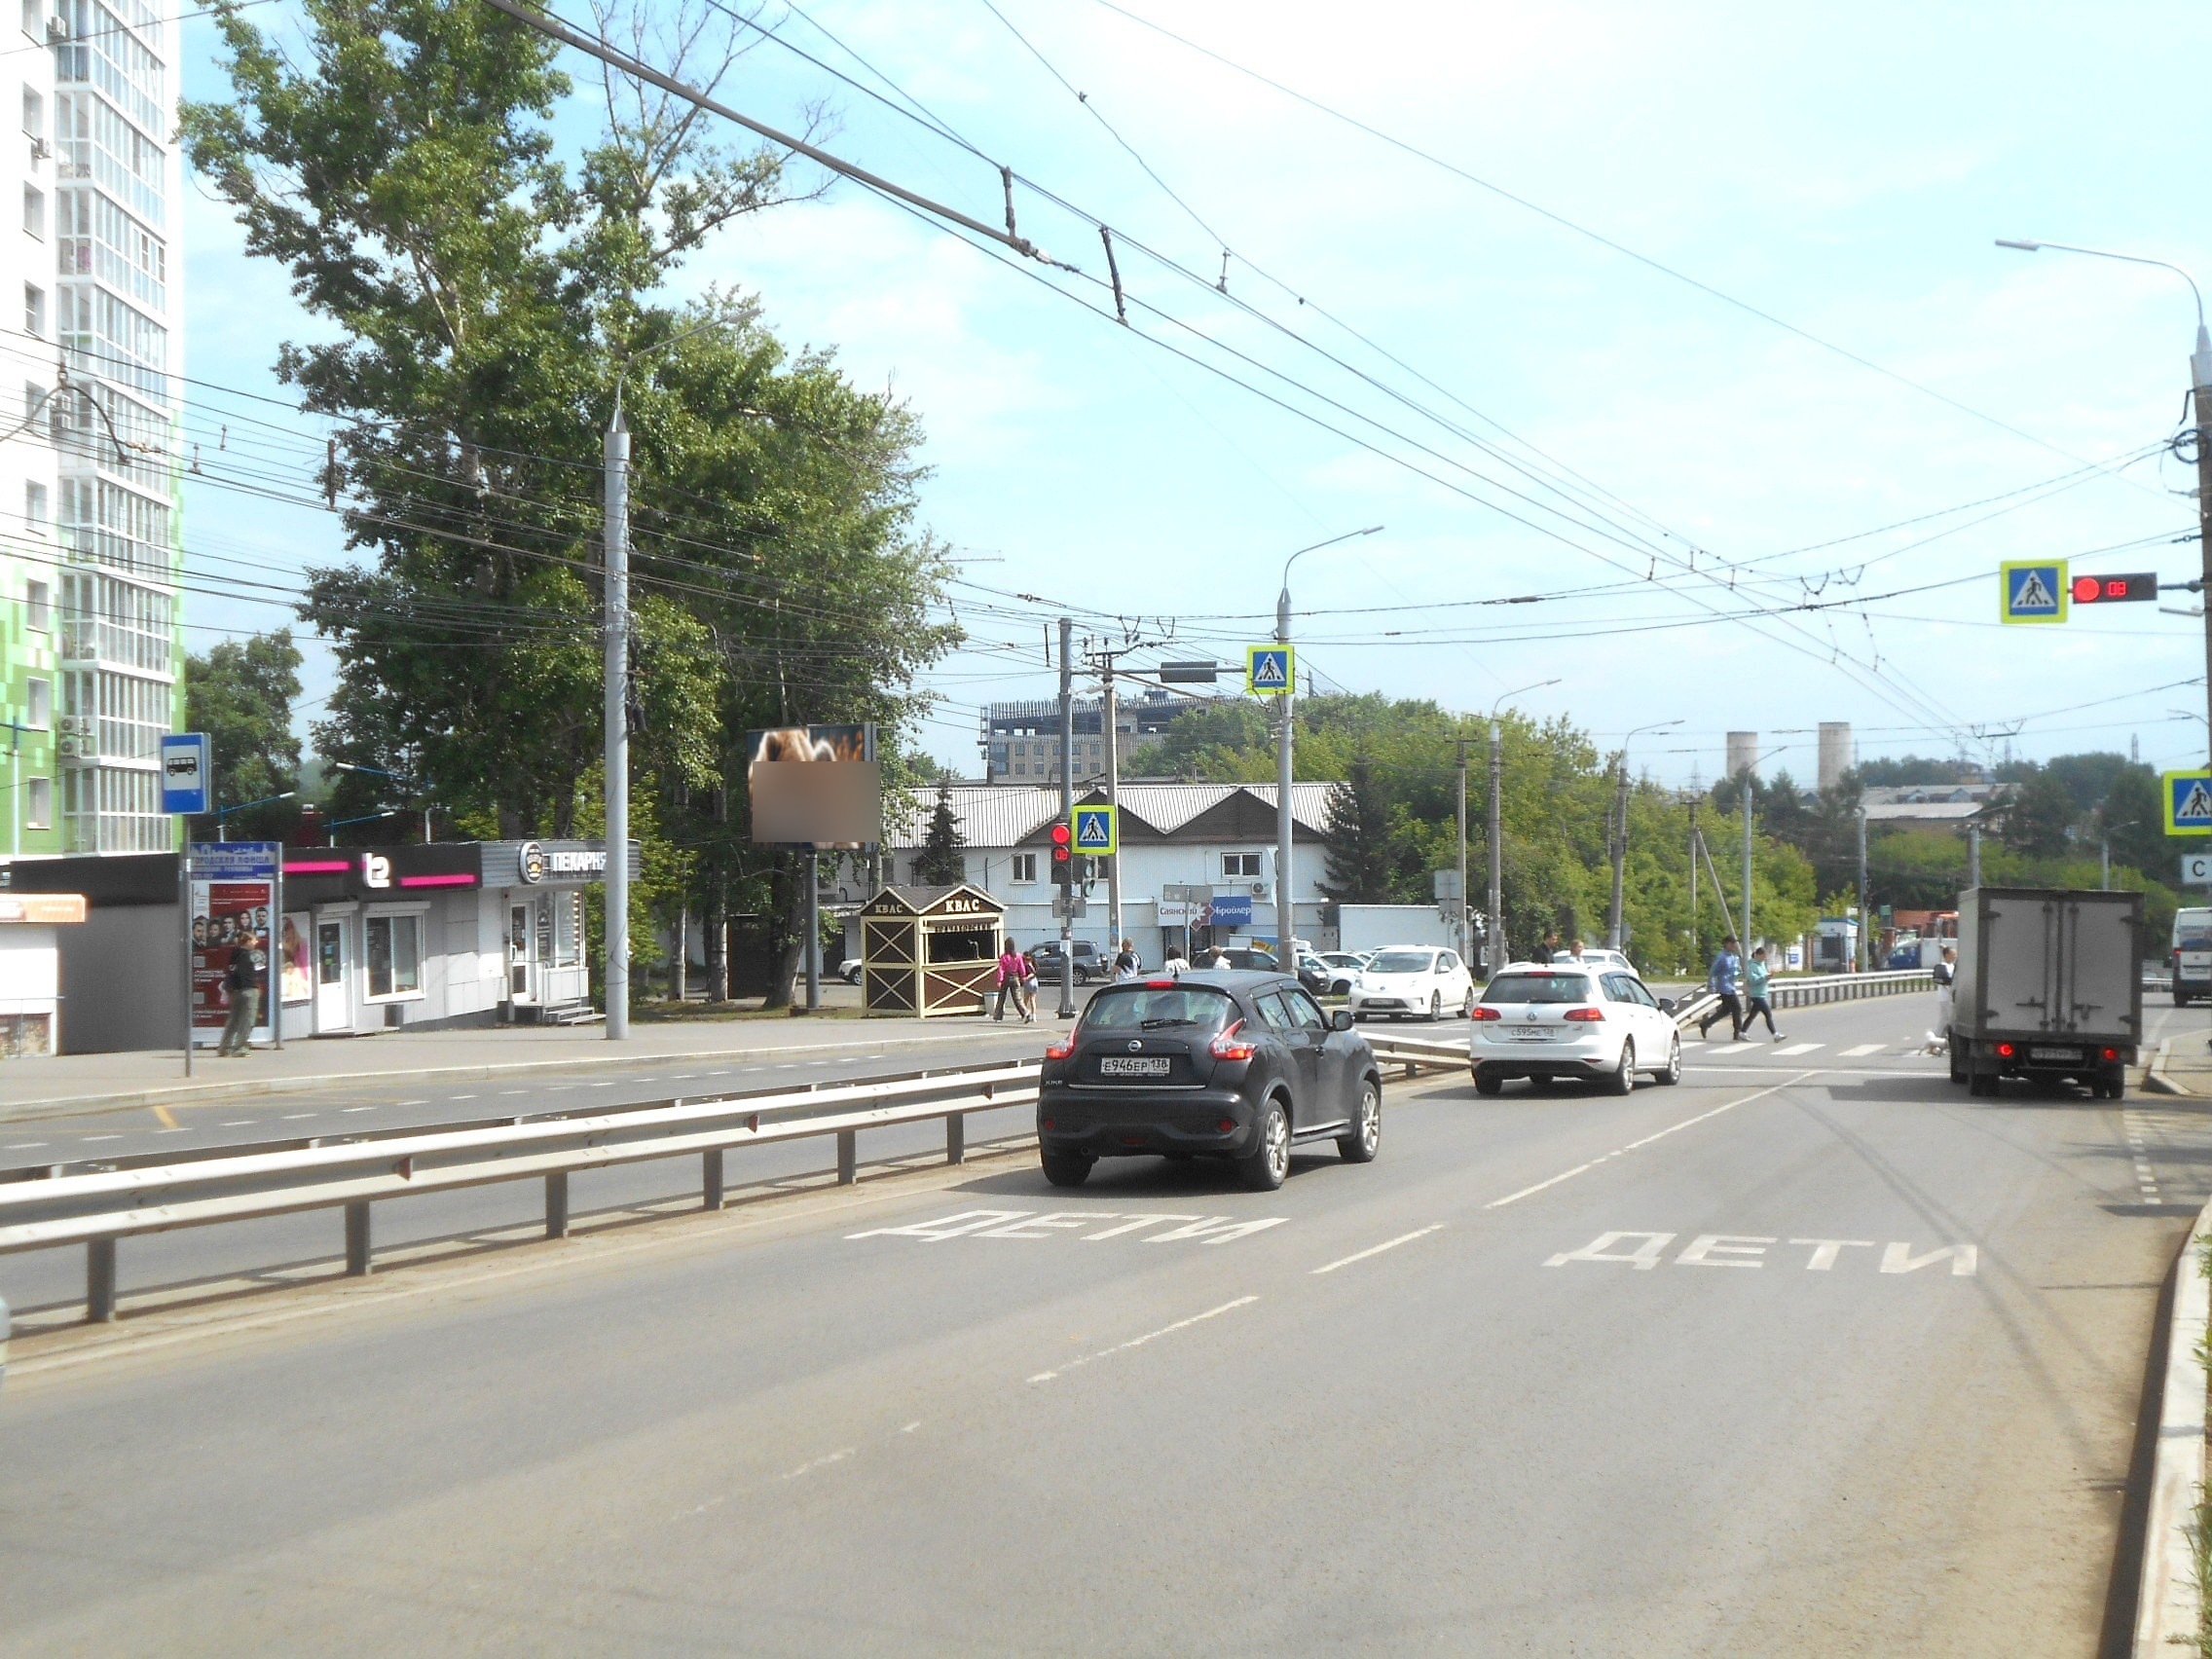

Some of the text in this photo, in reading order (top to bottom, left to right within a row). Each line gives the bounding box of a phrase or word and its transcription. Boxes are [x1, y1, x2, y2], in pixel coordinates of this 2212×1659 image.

[875, 904, 903, 913] КВАС
[945, 899, 979, 912] КВАС
[1215, 905, 1251, 916] Бройлер
[842, 1209, 1291, 1244] ДЕТИ
[1541, 1231, 1977, 1276] ДЕТИ
